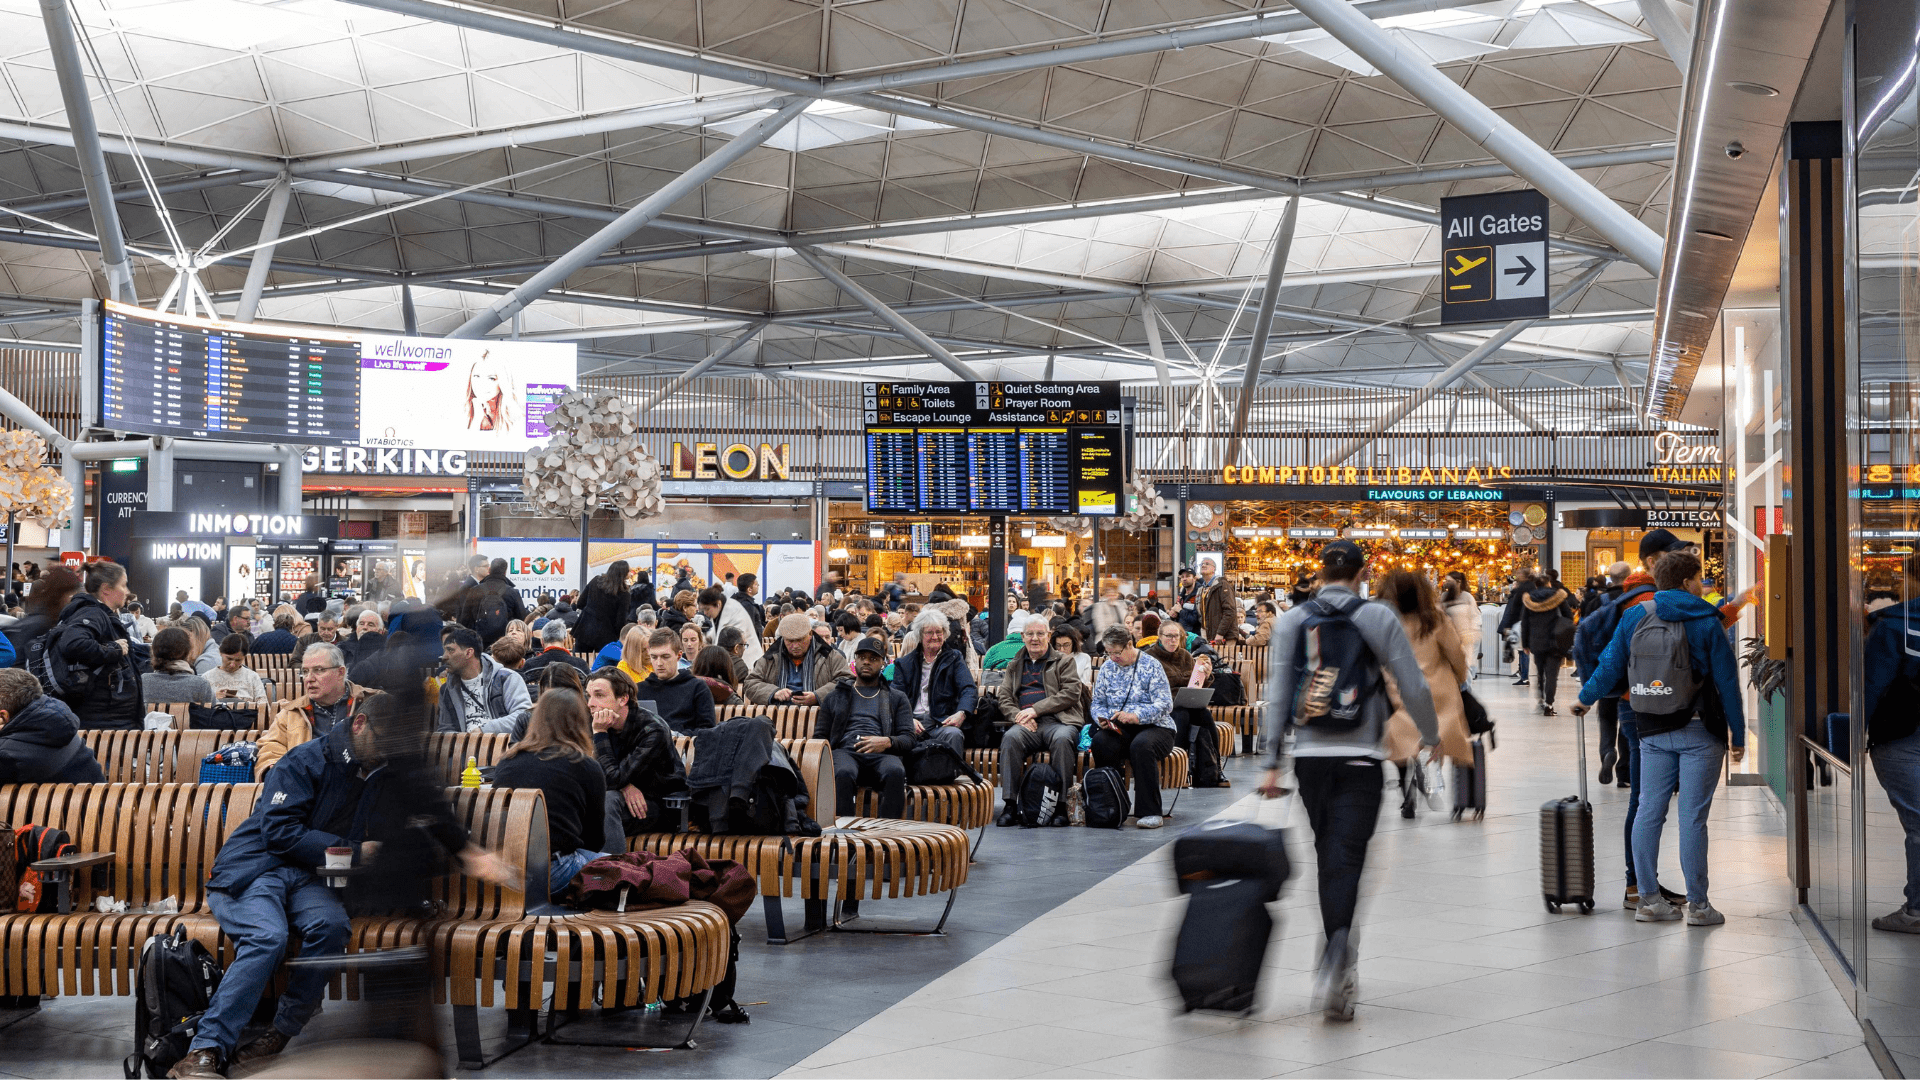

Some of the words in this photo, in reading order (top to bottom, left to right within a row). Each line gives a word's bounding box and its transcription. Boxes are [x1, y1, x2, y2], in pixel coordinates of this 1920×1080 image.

[1447, 216, 1473, 239] All
[1480, 213, 1542, 236] Gates
[374, 340, 452, 360] wellwoman
[374, 360, 391, 369] Live
[392, 360, 404, 370] life
[892, 384, 925, 395] Family
[927, 384, 950, 394] Area
[1004, 384, 1031, 395] Quiet
[1033, 384, 1073, 395] Seating
[1075, 384, 1100, 394] Area
[921, 398, 955, 408] Toilets
[1005, 398, 1038, 410] Prayer
[1040, 398, 1071, 408] Room
[893, 413, 930, 424] Escape
[933, 413, 971, 424] Lounge
[989, 412, 1045, 423] Assistance
[366, 438, 414, 446] VITABIOTICS
[301, 446, 368, 473] GER
[376, 448, 467, 475] KING
[672, 442, 790, 481] LEON
[1223, 464, 1358, 484] COMPTOIR
[1367, 466, 1511, 484] LIBANAIS
[1654, 467, 1721, 481] ITALIAN
[107, 492, 148, 504] CURRENCY
[1369, 490, 1425, 500] FLAVOURS
[1429, 490, 1444, 500] OF
[1447, 490, 1503, 500] LEBANON
[1647, 510, 1720, 521] BOTTEGA
[190, 514, 302, 534] INMOTION
[152, 544, 221, 560] INMOTION
[65, 558, 80, 567] ATM
[510, 556, 566, 575] LEON
[519, 585, 568, 599] nding
[1630, 683, 1673, 696] ellesse
[1036, 785, 1060, 826] NIKE
